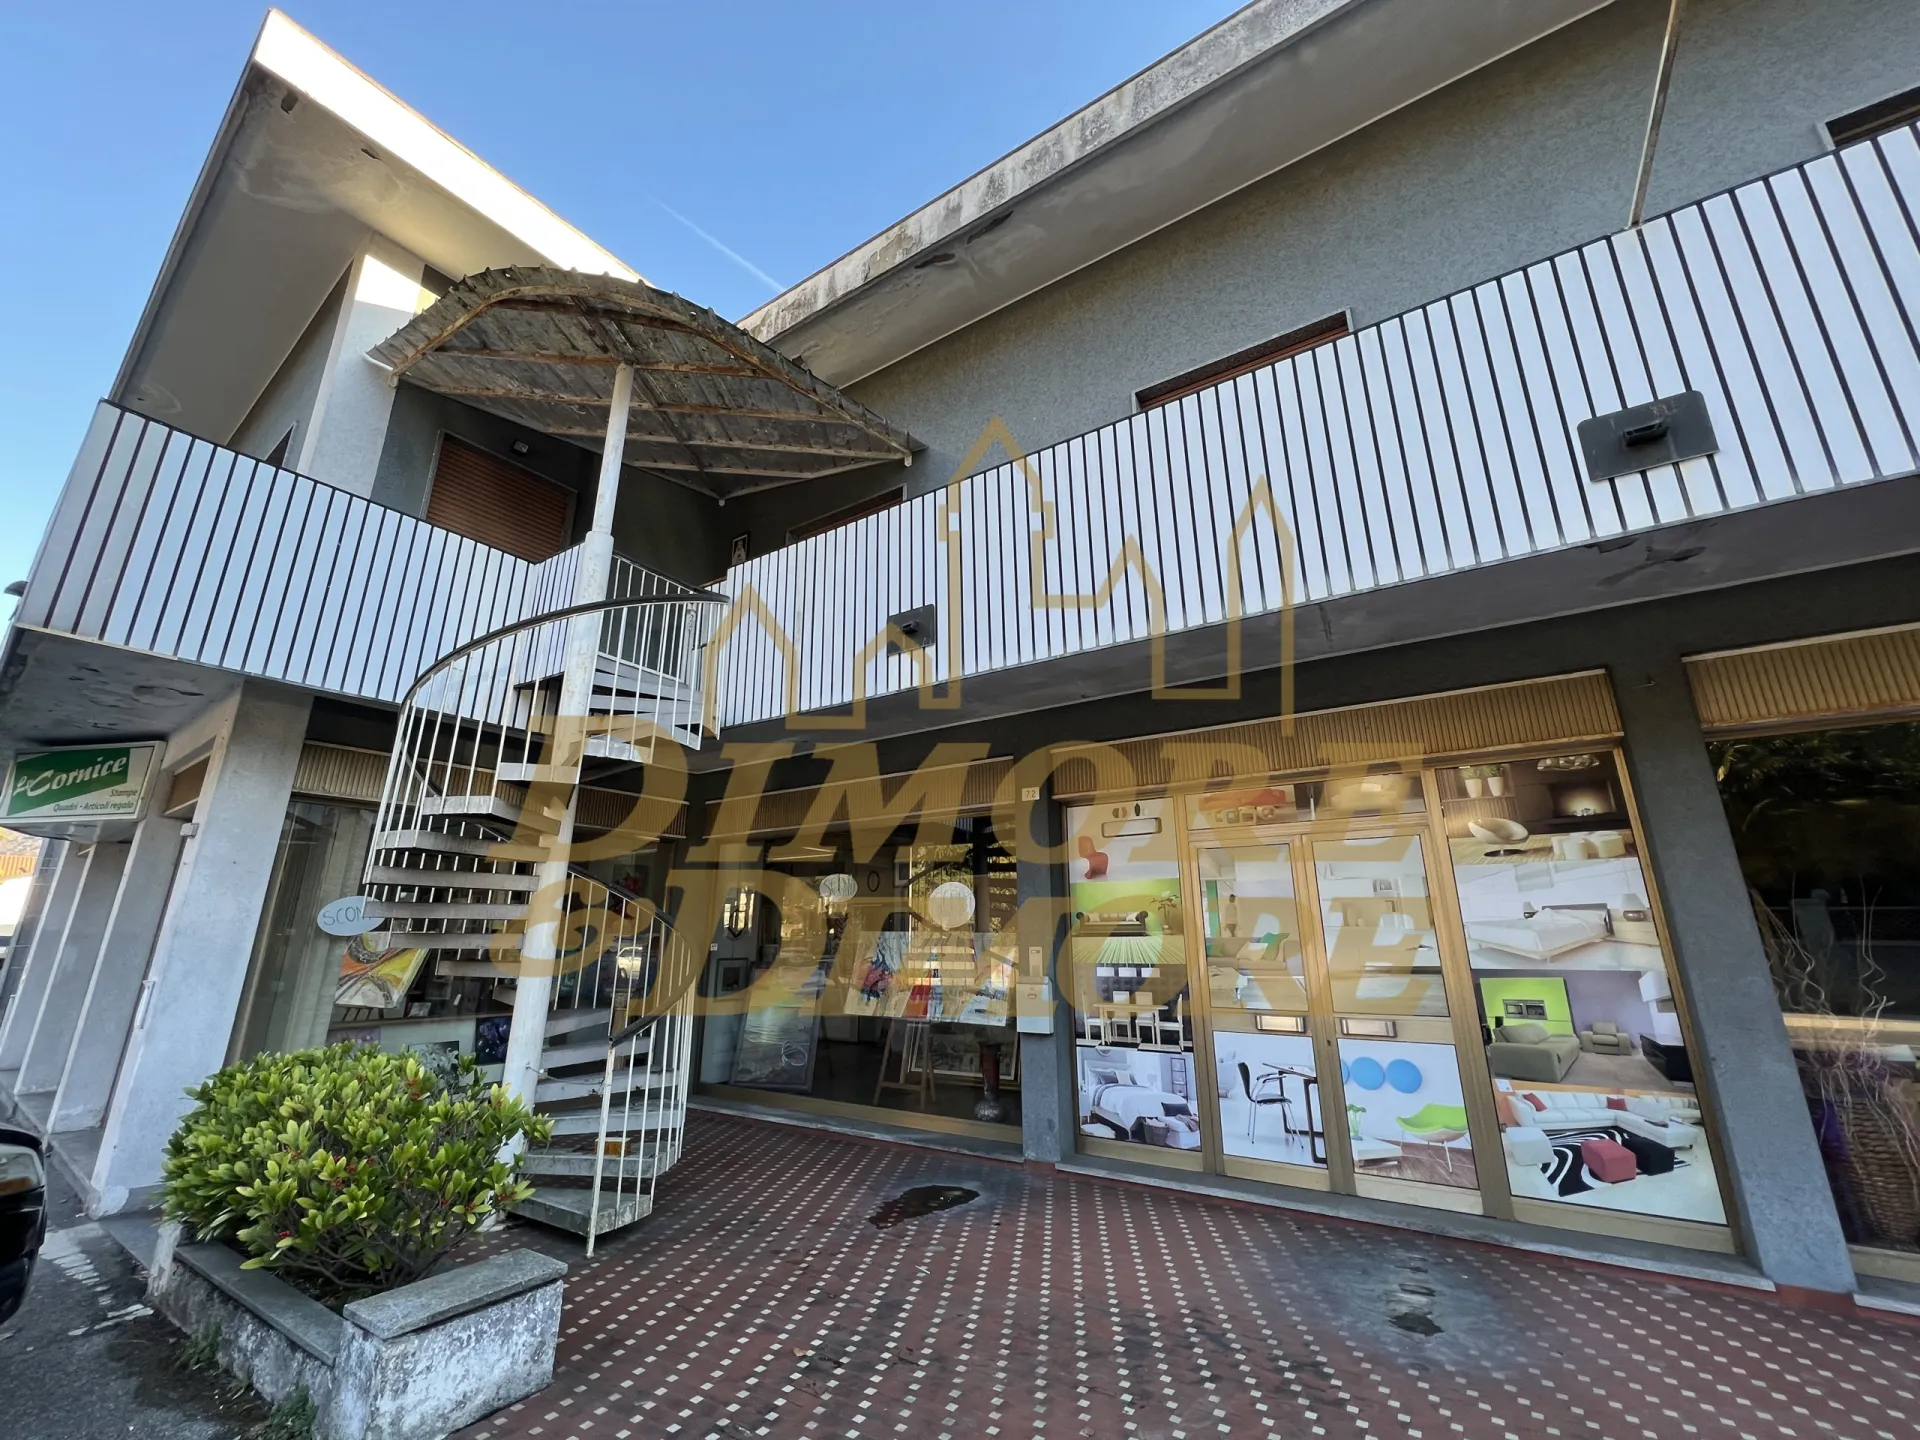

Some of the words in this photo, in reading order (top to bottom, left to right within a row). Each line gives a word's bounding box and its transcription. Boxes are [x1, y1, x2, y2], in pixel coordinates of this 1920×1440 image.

[27, 756, 127, 797] Cornice
[1025, 789, 1036, 798] 72
[53, 802, 79, 812] Quadri
[82, 801, 109, 811] Articoli
[110, 801, 134, 811] regalo
